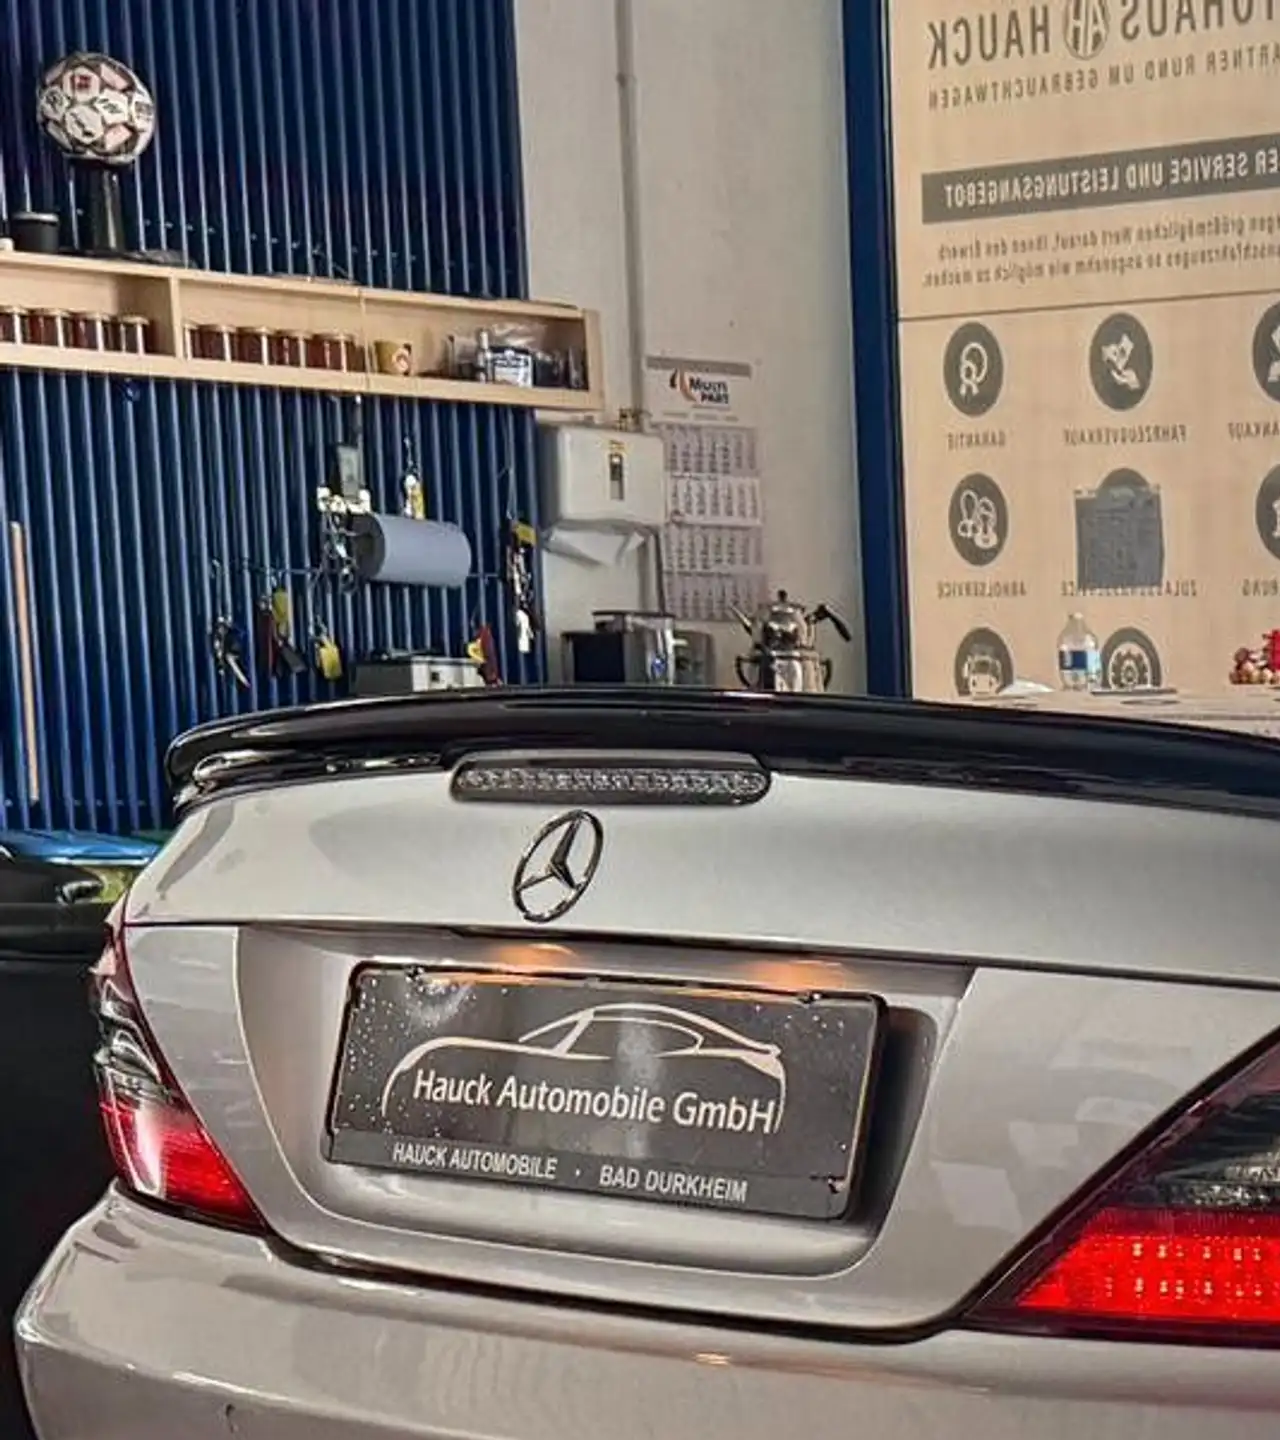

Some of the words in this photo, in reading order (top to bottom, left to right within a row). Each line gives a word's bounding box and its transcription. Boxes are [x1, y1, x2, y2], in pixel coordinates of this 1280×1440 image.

[413, 1067, 491, 1107] Hauck
[496, 1075, 664, 1124] Automobile
[672, 1091, 777, 1135] GmbH
[392, 1141, 448, 1168] HAUCK
[449, 1147, 559, 1181] AUTOMOBILE
[599, 1163, 641, 1190] BAD
